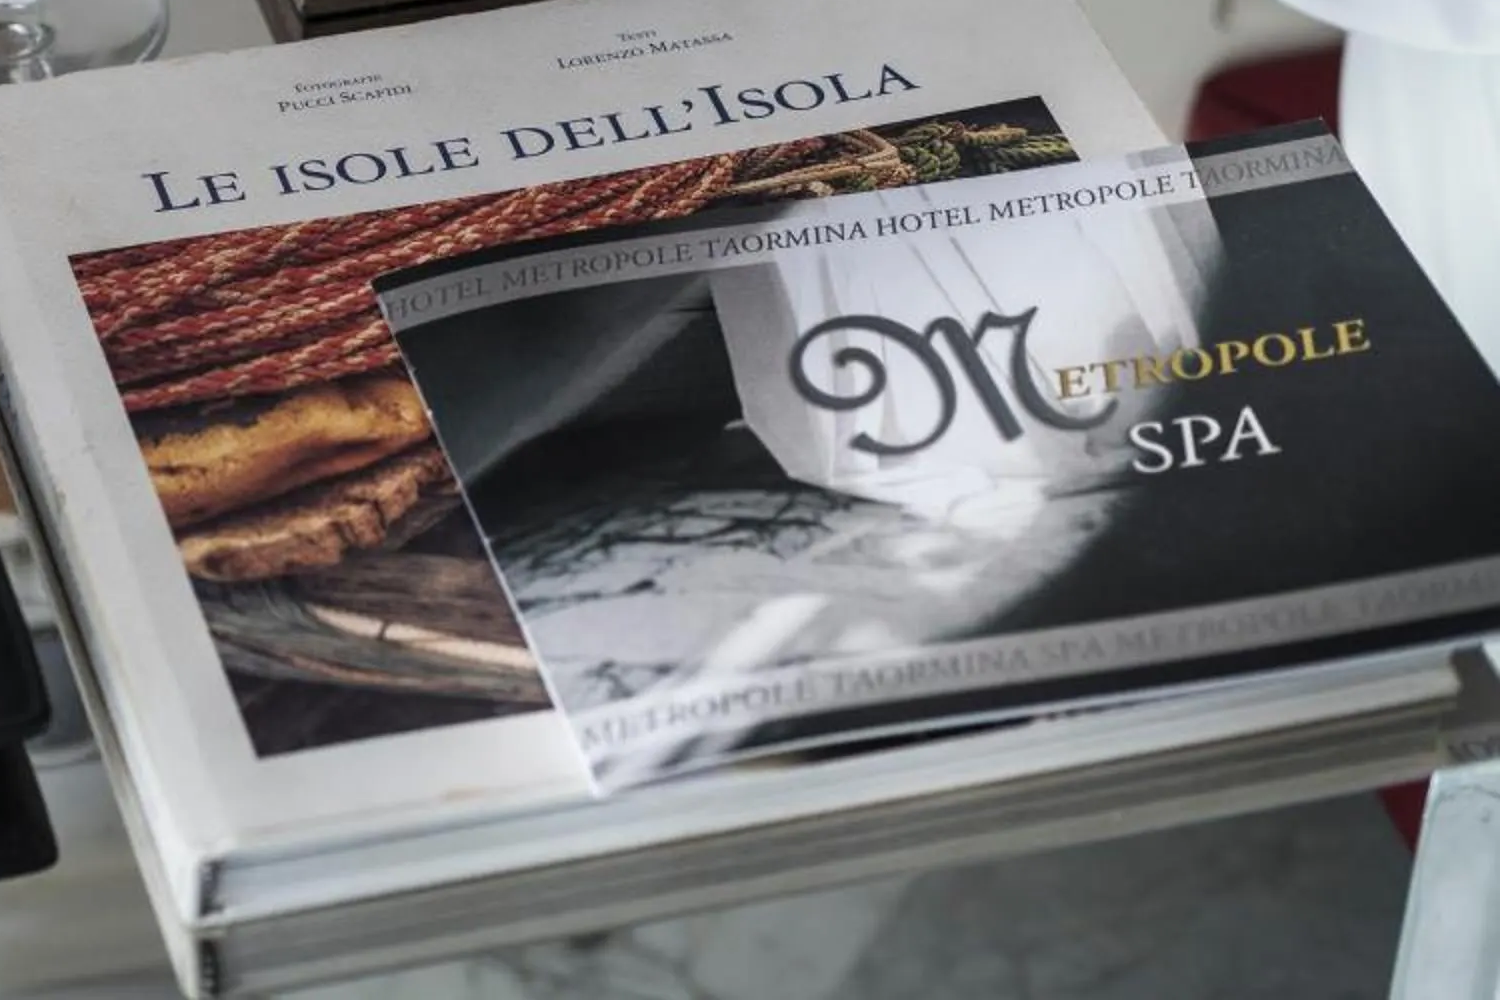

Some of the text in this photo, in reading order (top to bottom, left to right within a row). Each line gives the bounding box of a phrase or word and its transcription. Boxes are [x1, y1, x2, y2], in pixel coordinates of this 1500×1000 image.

[277, 96, 336, 113] PUCCI
[556, 32, 734, 70] LORENZO MATASSA
[141, 62, 922, 213] LE ISOLE DELL'ISOLA
[387, 276, 491, 321] HOTEL
[502, 242, 694, 292] METROPOLE
[701, 219, 867, 259] TAORMINA
[876, 206, 981, 235] HOTEL
[991, 175, 1175, 221] METROPOLE
[1128, 404, 1282, 474] SPA
[583, 679, 818, 750] METROPOLE
[831, 645, 1030, 700] TAORMINA
[1040, 633, 1107, 662] SPA
[1115, 598, 1341, 656] METROPOLE
